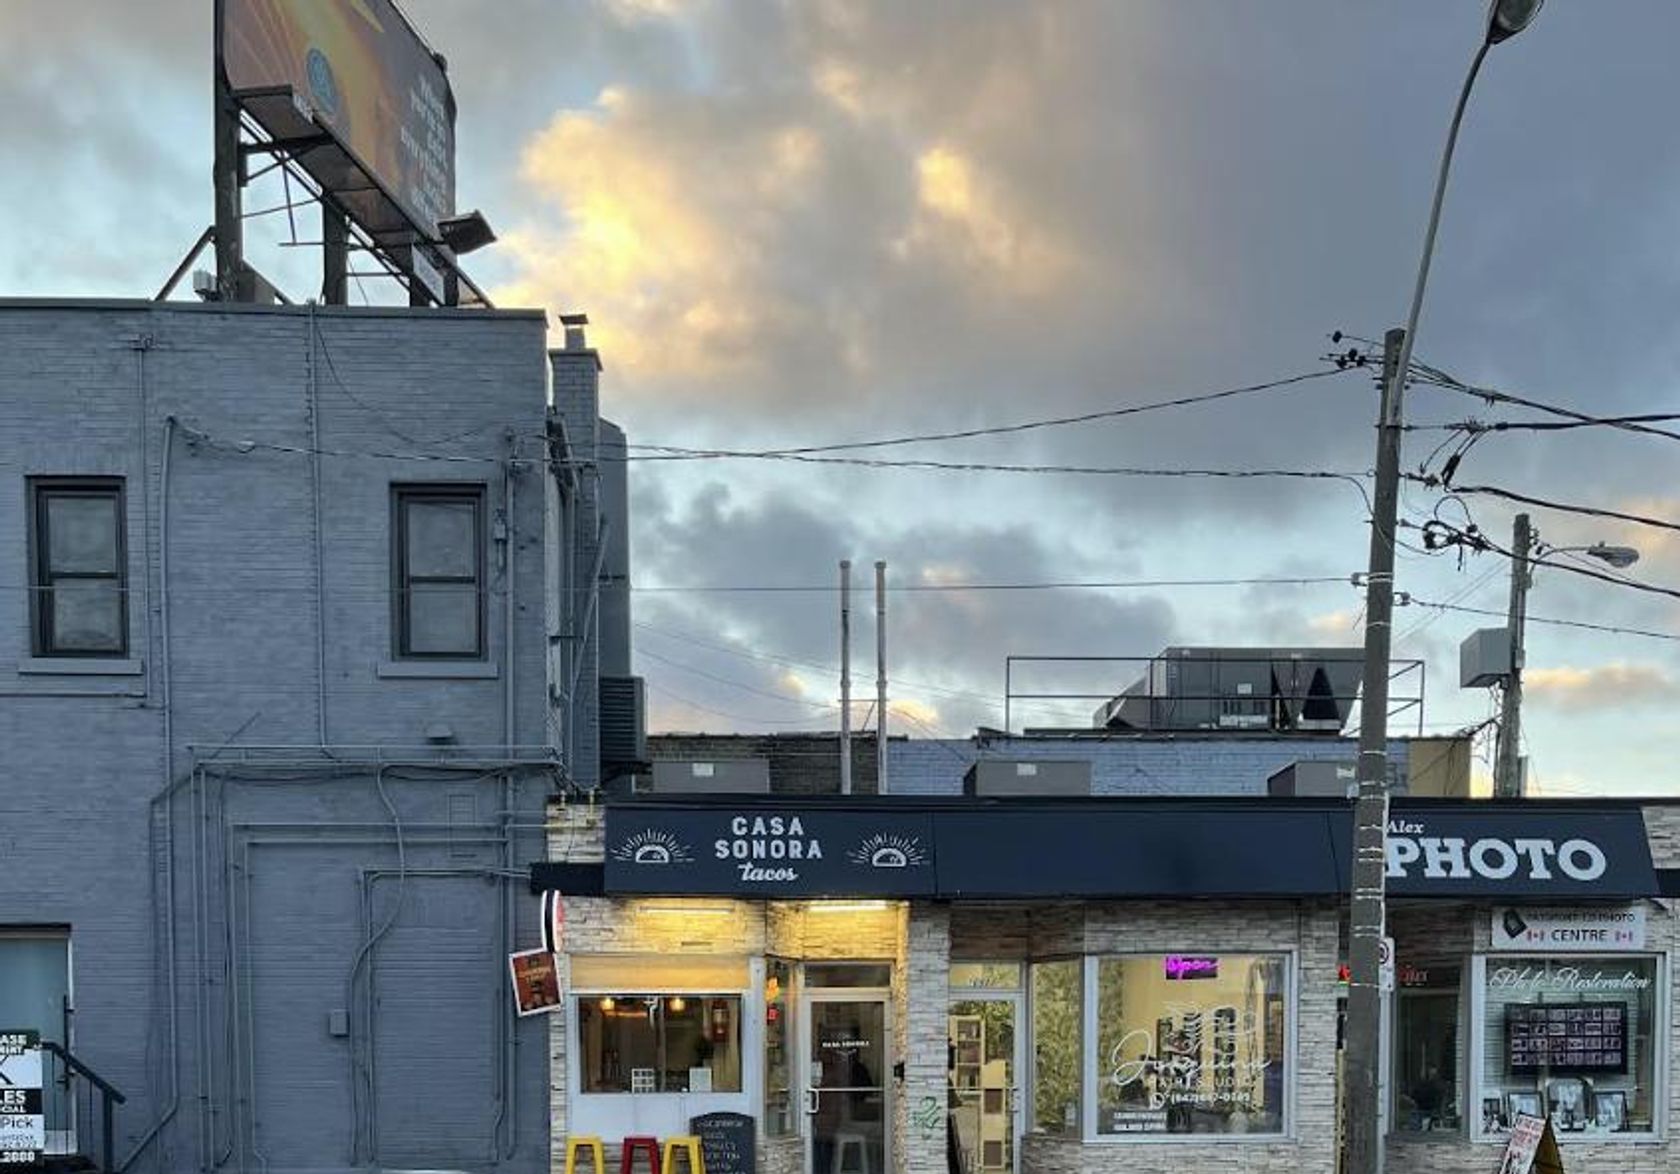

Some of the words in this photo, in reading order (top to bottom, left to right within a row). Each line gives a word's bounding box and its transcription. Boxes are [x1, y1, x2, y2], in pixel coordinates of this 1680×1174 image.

[732, 816, 804, 835] CASA
[1386, 820, 1424, 834] Alex
[714, 839, 822, 859] SONORA
[1385, 837, 1607, 881] PHOTO
[737, 861, 799, 881] tacos
[1551, 929, 1608, 942] CENTRE
[1489, 967, 1547, 990] Photo
[1552, 967, 1650, 990] Restoration
